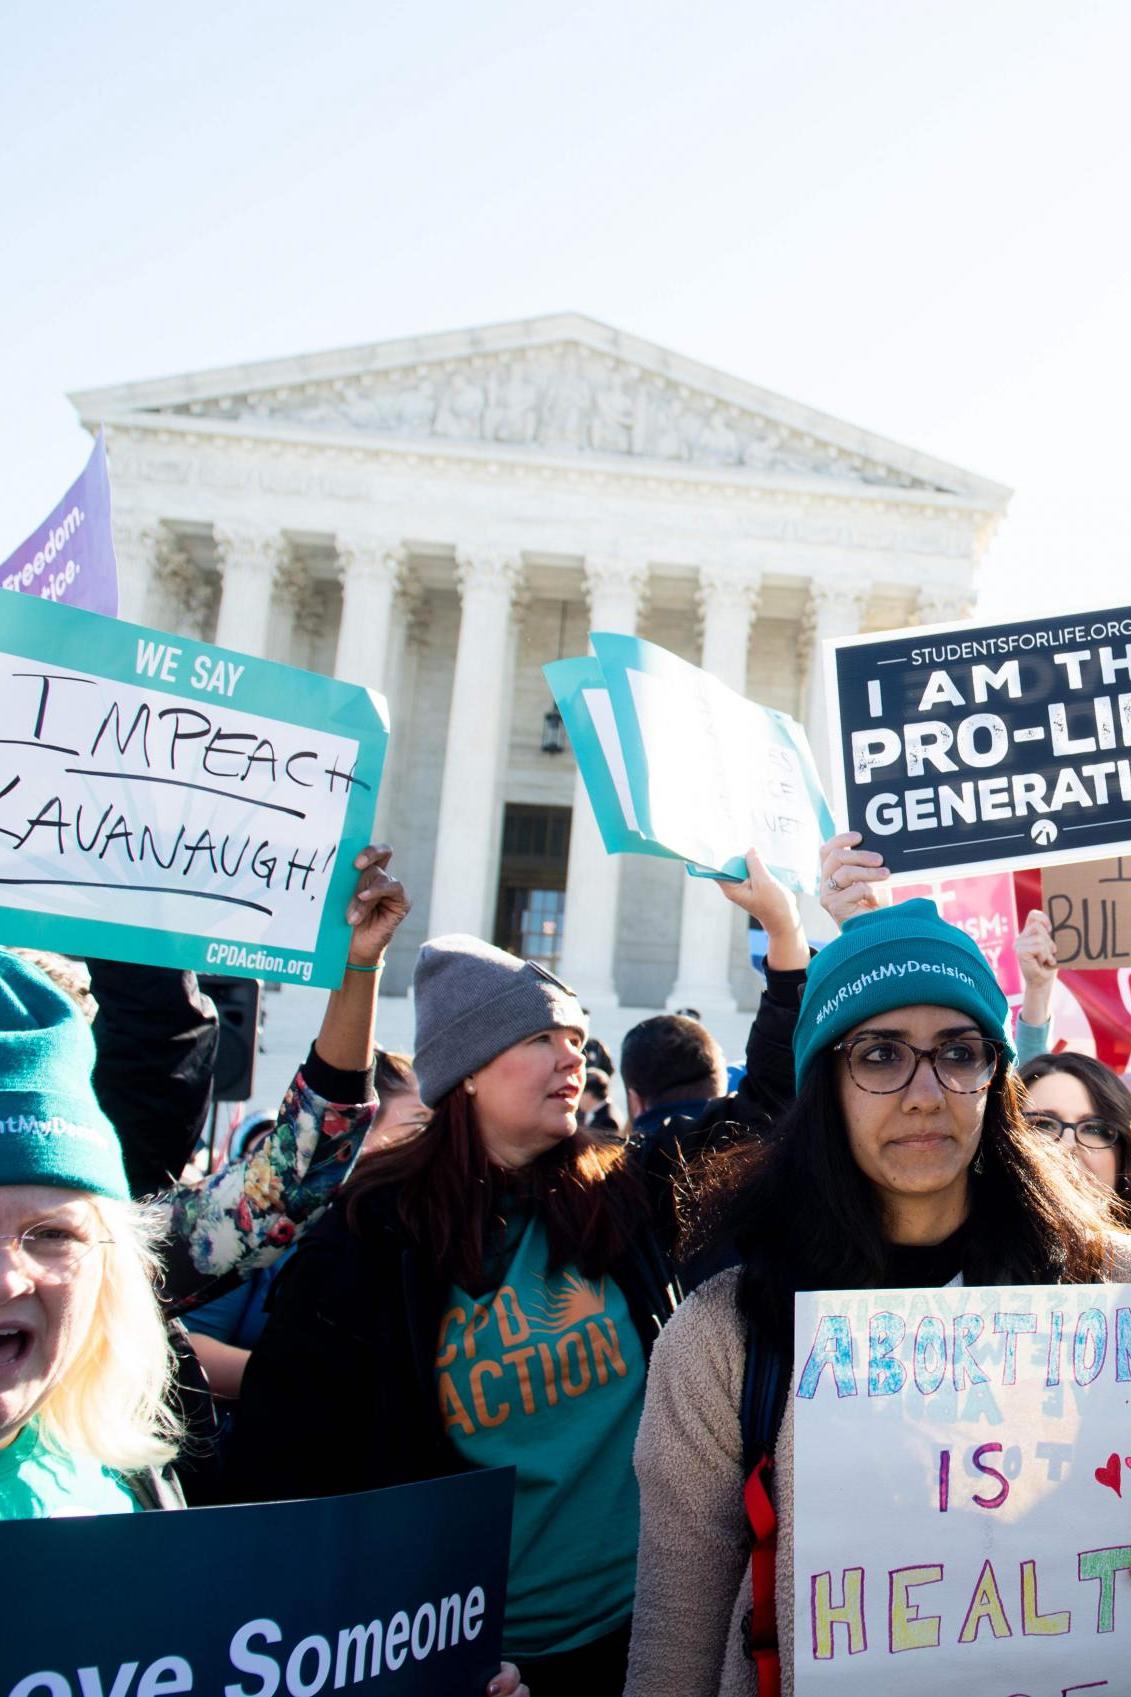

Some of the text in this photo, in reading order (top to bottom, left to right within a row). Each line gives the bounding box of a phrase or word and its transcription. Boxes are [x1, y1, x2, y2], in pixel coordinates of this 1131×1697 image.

[135, 640, 245, 697] WE SAY
[867, 680, 883, 718] I
[918, 660, 1022, 712] AM
[0, 674, 371, 793] IMPEACH
[206, 943, 313, 980] CPDAction.org
[816, 960, 976, 1024] #MyRightMyDecision
[435, 1285, 531, 1368] CPD
[437, 1317, 627, 1437] ACTION
[939, 1442, 1010, 1513] IS
[225, 1585, 486, 1697] Someone
